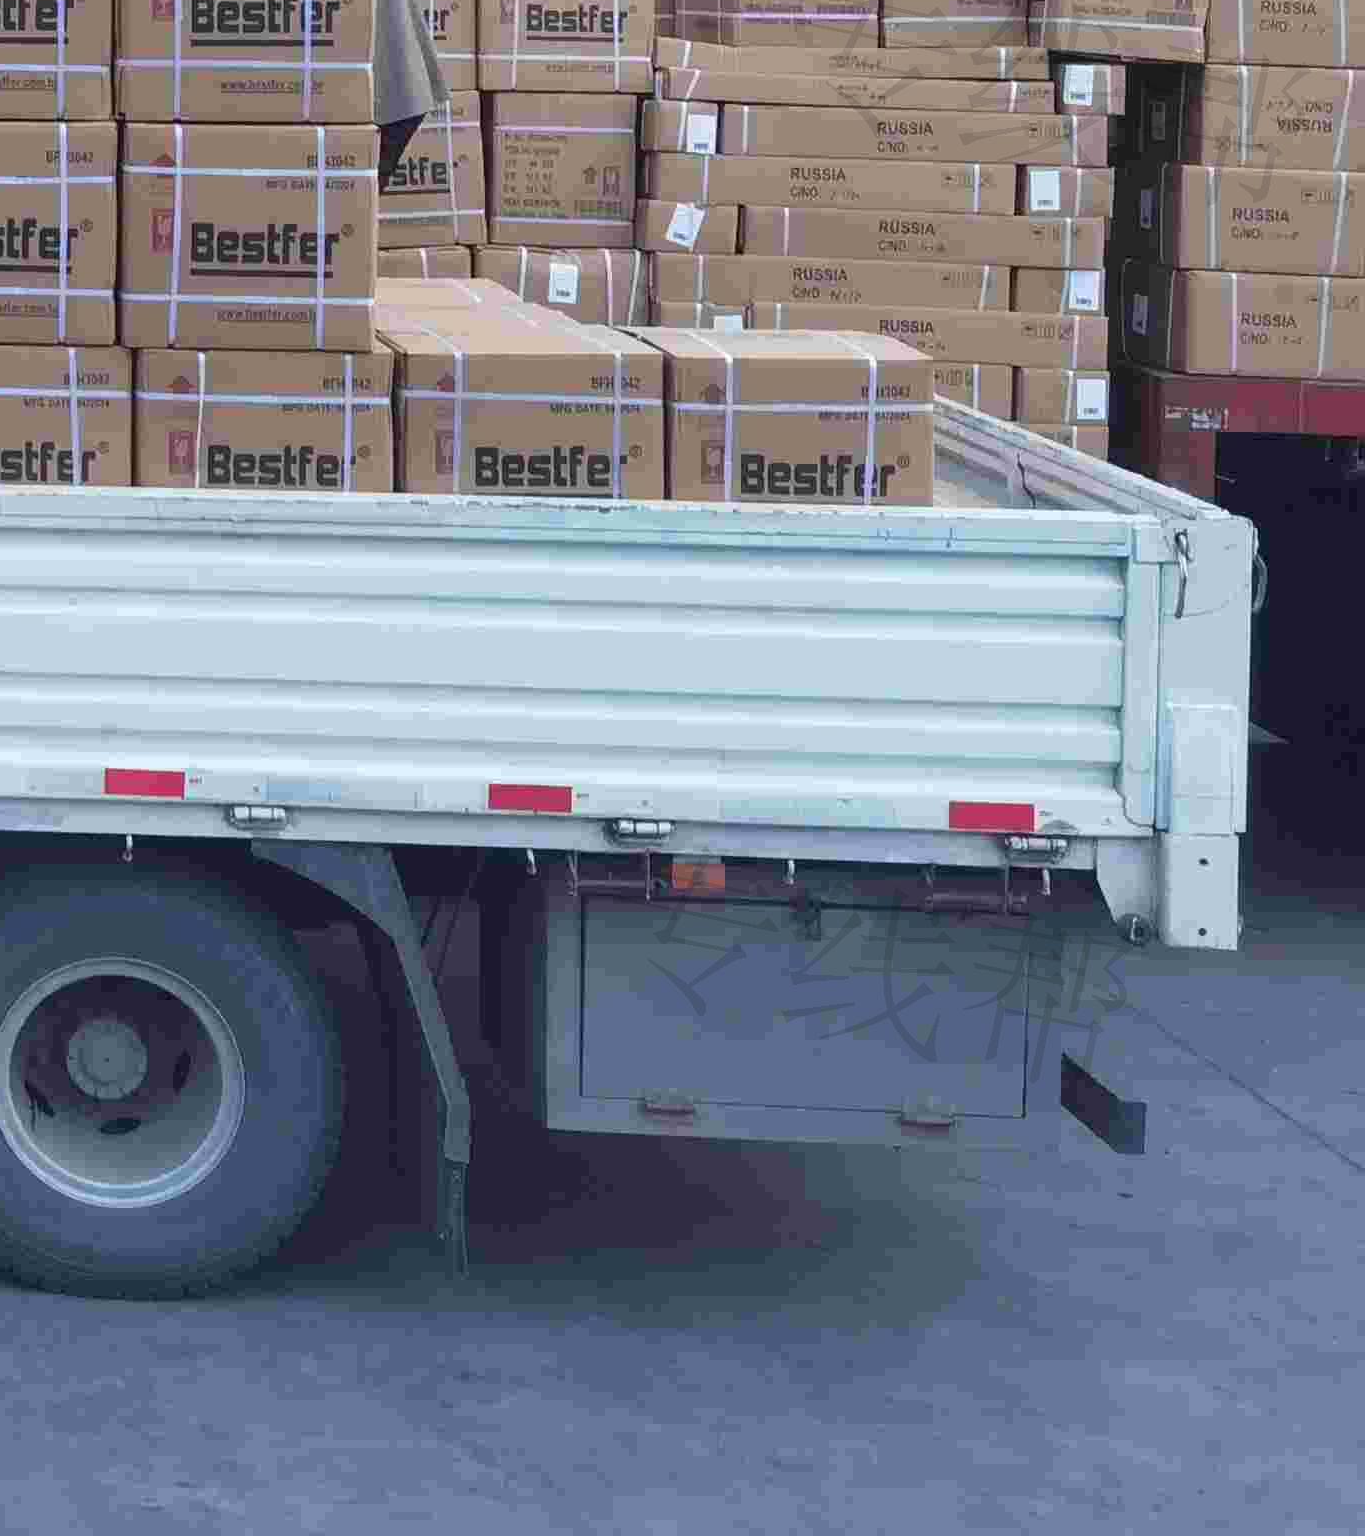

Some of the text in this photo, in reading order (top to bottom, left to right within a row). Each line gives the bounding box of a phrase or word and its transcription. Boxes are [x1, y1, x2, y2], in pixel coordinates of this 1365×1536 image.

[1259, 0, 1318, 17] RUSSIA
[526, 4, 628, 33] Bestfer
[876, 121, 934, 136] RUSSIA
[1276, 116, 1333, 133] RUSSIA
[789, 167, 846, 182] RUSSIA
[1231, 207, 1291, 224] RUSSIA
[877, 221, 936, 236] RUSSIA
[189, 222, 341, 265] Bestfer
[791, 267, 848, 282] RUSSIA
[878, 320, 935, 336] RUSSIA
[1240, 311, 1298, 329] RUSSIA
[473, 446, 629, 488] Bestfe
